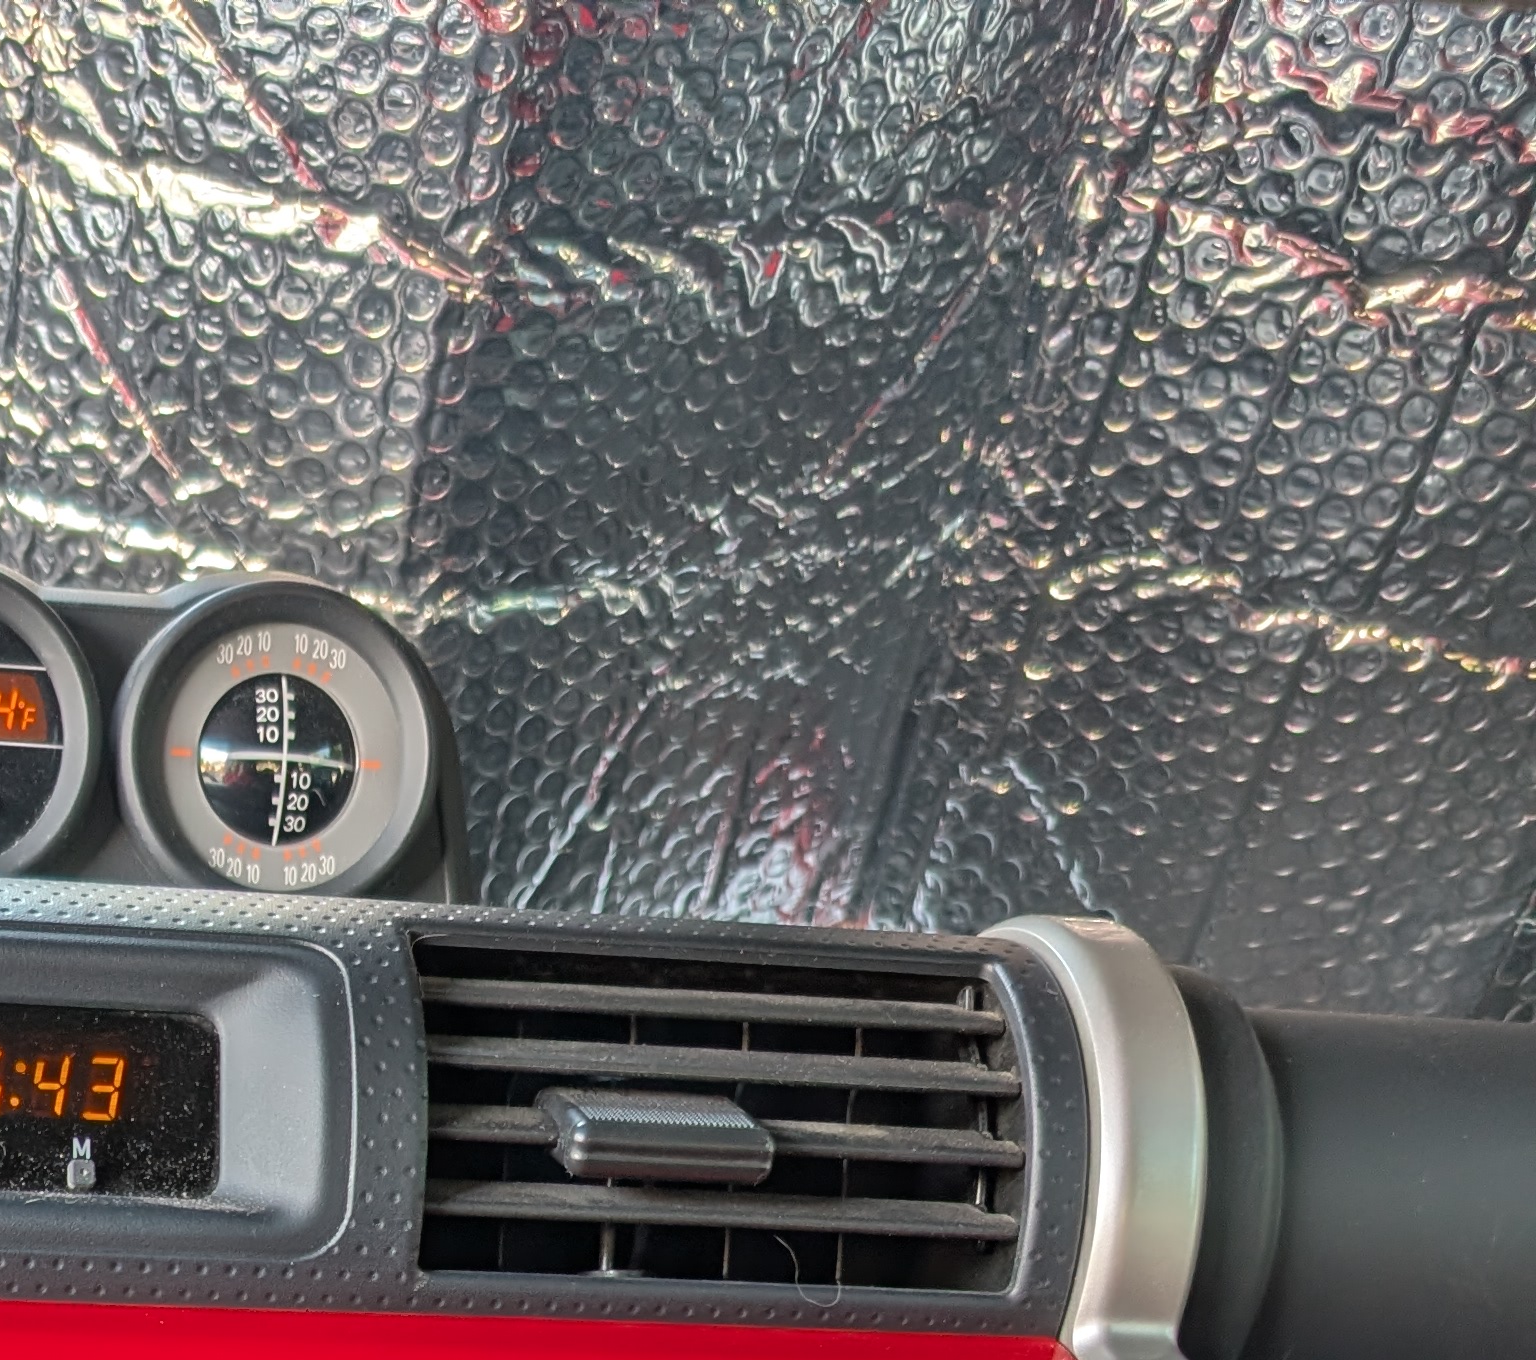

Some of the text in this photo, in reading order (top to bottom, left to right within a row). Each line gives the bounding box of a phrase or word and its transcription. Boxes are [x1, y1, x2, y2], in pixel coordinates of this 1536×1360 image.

[216, 631, 346, 670] 30 20 10 10 20 30
[255, 688, 279, 703] 30
[256, 707, 279, 722] 20
[257, 727, 279, 743] 10
[290, 773, 311, 790] 10
[287, 794, 309, 811] 20
[283, 816, 306, 832] 30
[209, 848, 336, 886] 30 20 10 10 20 30
[72, 1137, 91, 1160] M
